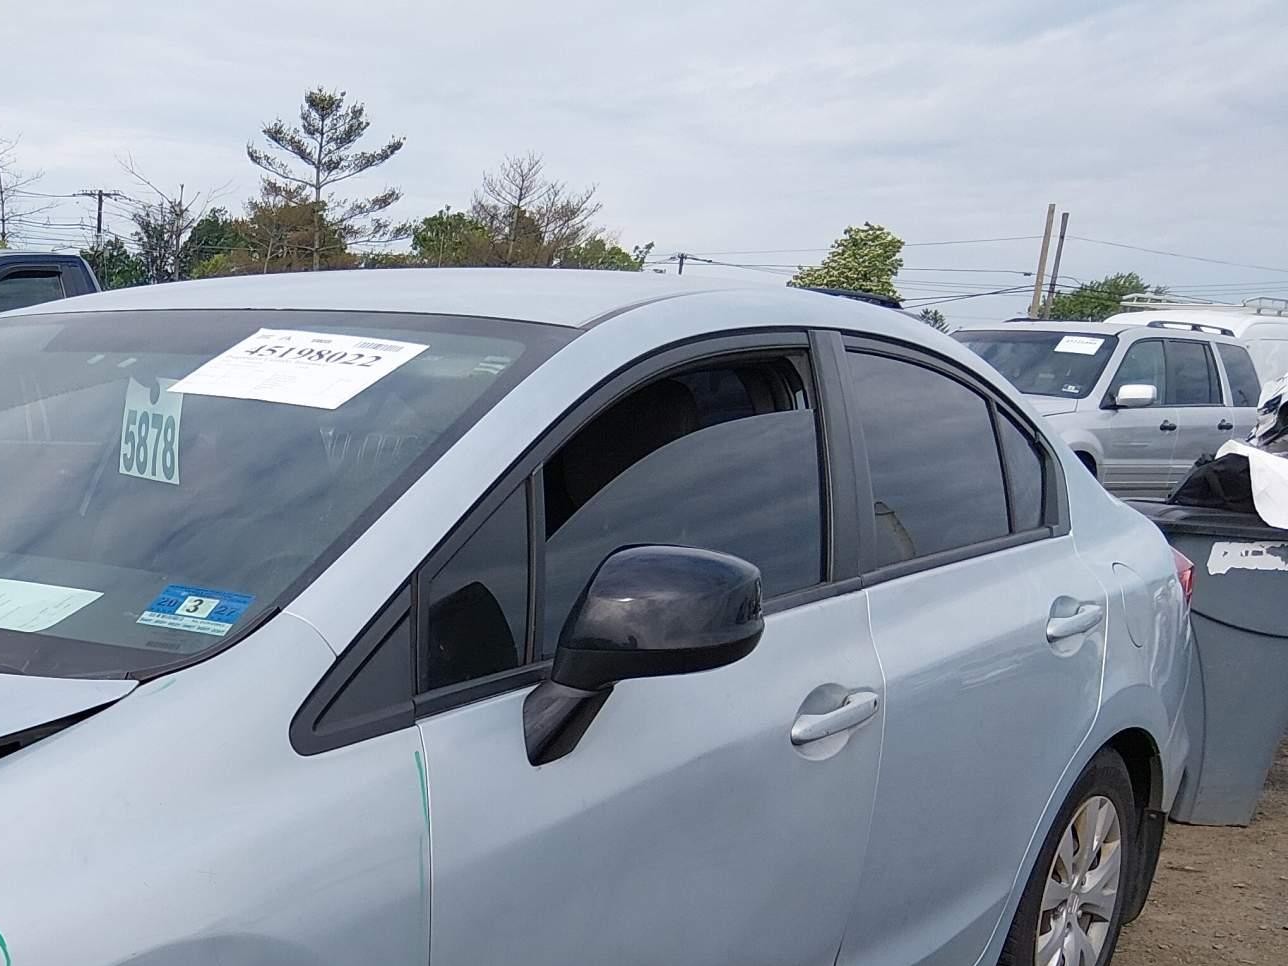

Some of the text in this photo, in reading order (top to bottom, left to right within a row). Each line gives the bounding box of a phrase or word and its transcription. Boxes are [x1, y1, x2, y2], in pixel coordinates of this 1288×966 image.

[244, 344, 382, 367] 45198022
[122, 409, 175, 480] 5878
[157, 599, 179, 607] 20
[185, 599, 204, 613] 3
